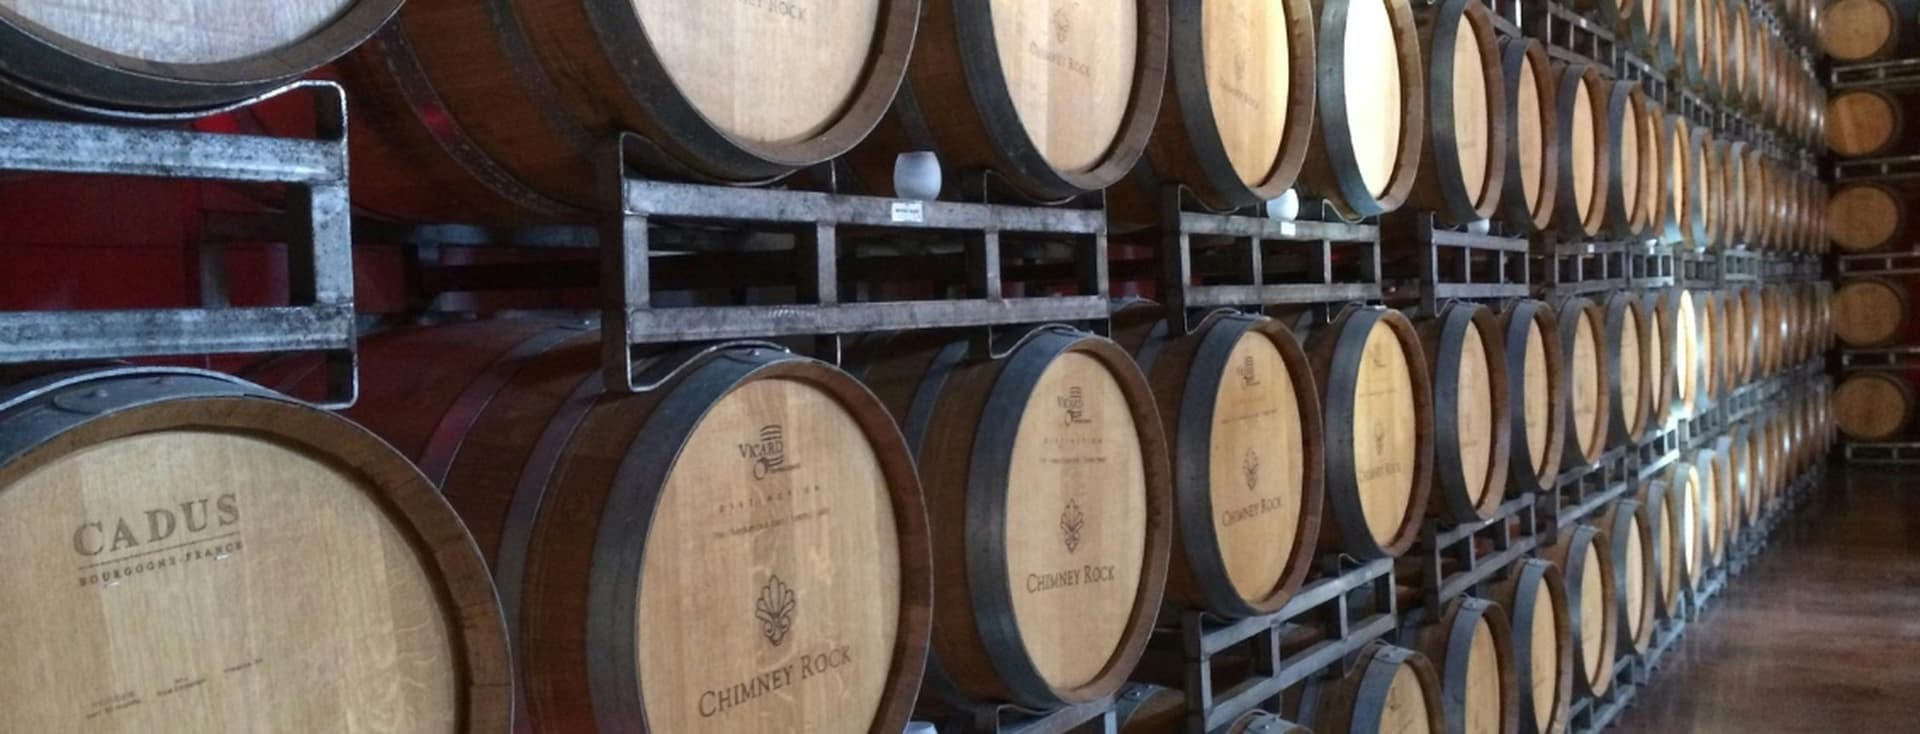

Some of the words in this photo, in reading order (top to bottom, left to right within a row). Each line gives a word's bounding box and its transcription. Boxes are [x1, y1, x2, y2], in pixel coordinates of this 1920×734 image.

[73, 494, 240, 557] CADUS
[1026, 569, 1080, 594] CHIMNEY
[1083, 564, 1115, 584] ROCK
[697, 664, 794, 718] CHIMNEY
[799, 646, 852, 680] ROCK
